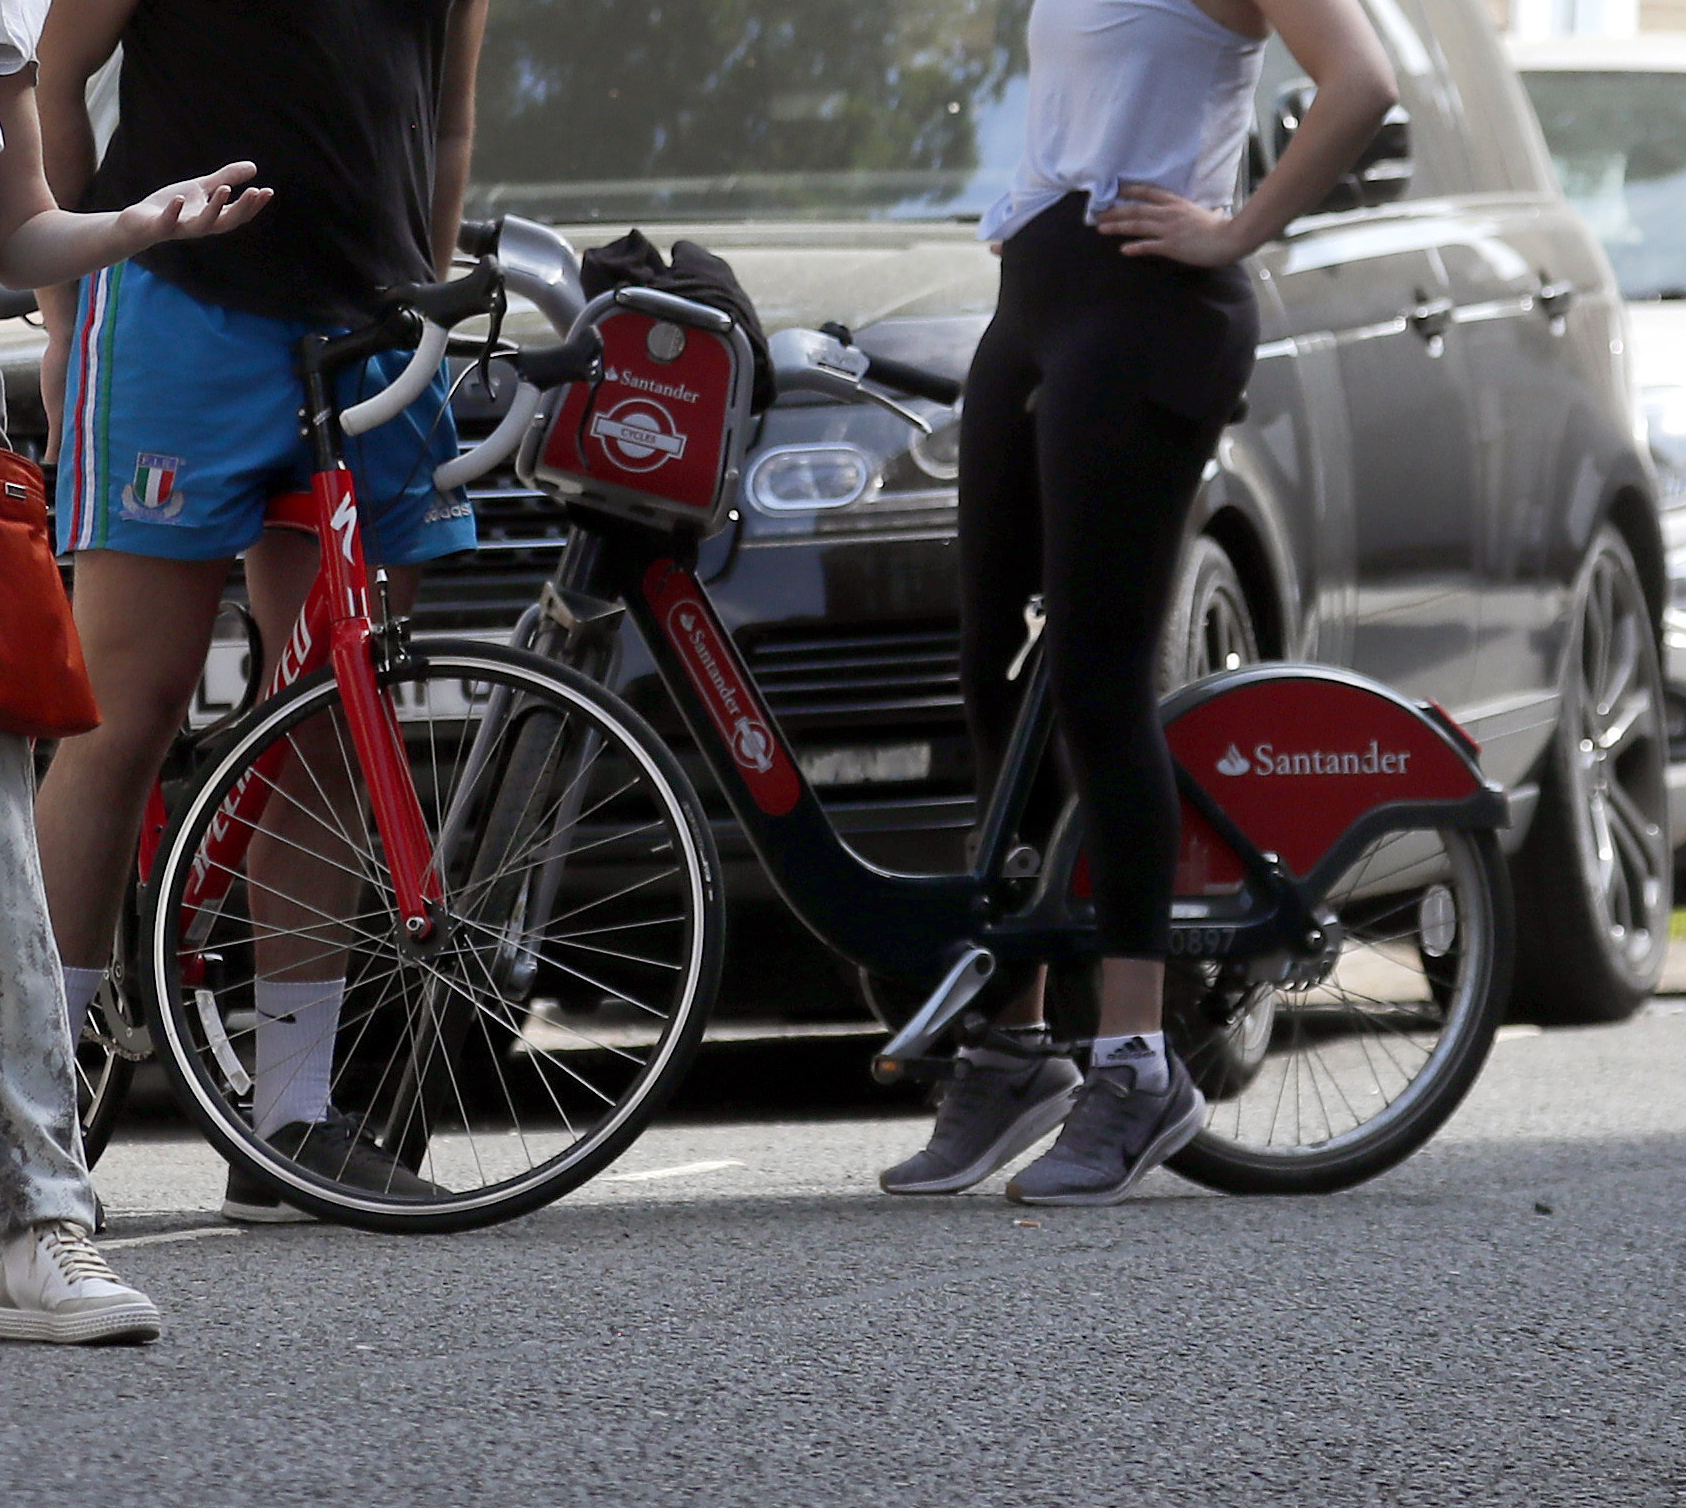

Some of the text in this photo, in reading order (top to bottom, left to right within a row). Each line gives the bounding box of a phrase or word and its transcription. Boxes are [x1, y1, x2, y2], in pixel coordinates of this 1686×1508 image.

[620, 370, 700, 404] Santander
[621, 428, 656, 444] CYCLES
[691, 630, 741, 715] Santander
[1254, 740, 1411, 776] Santander
